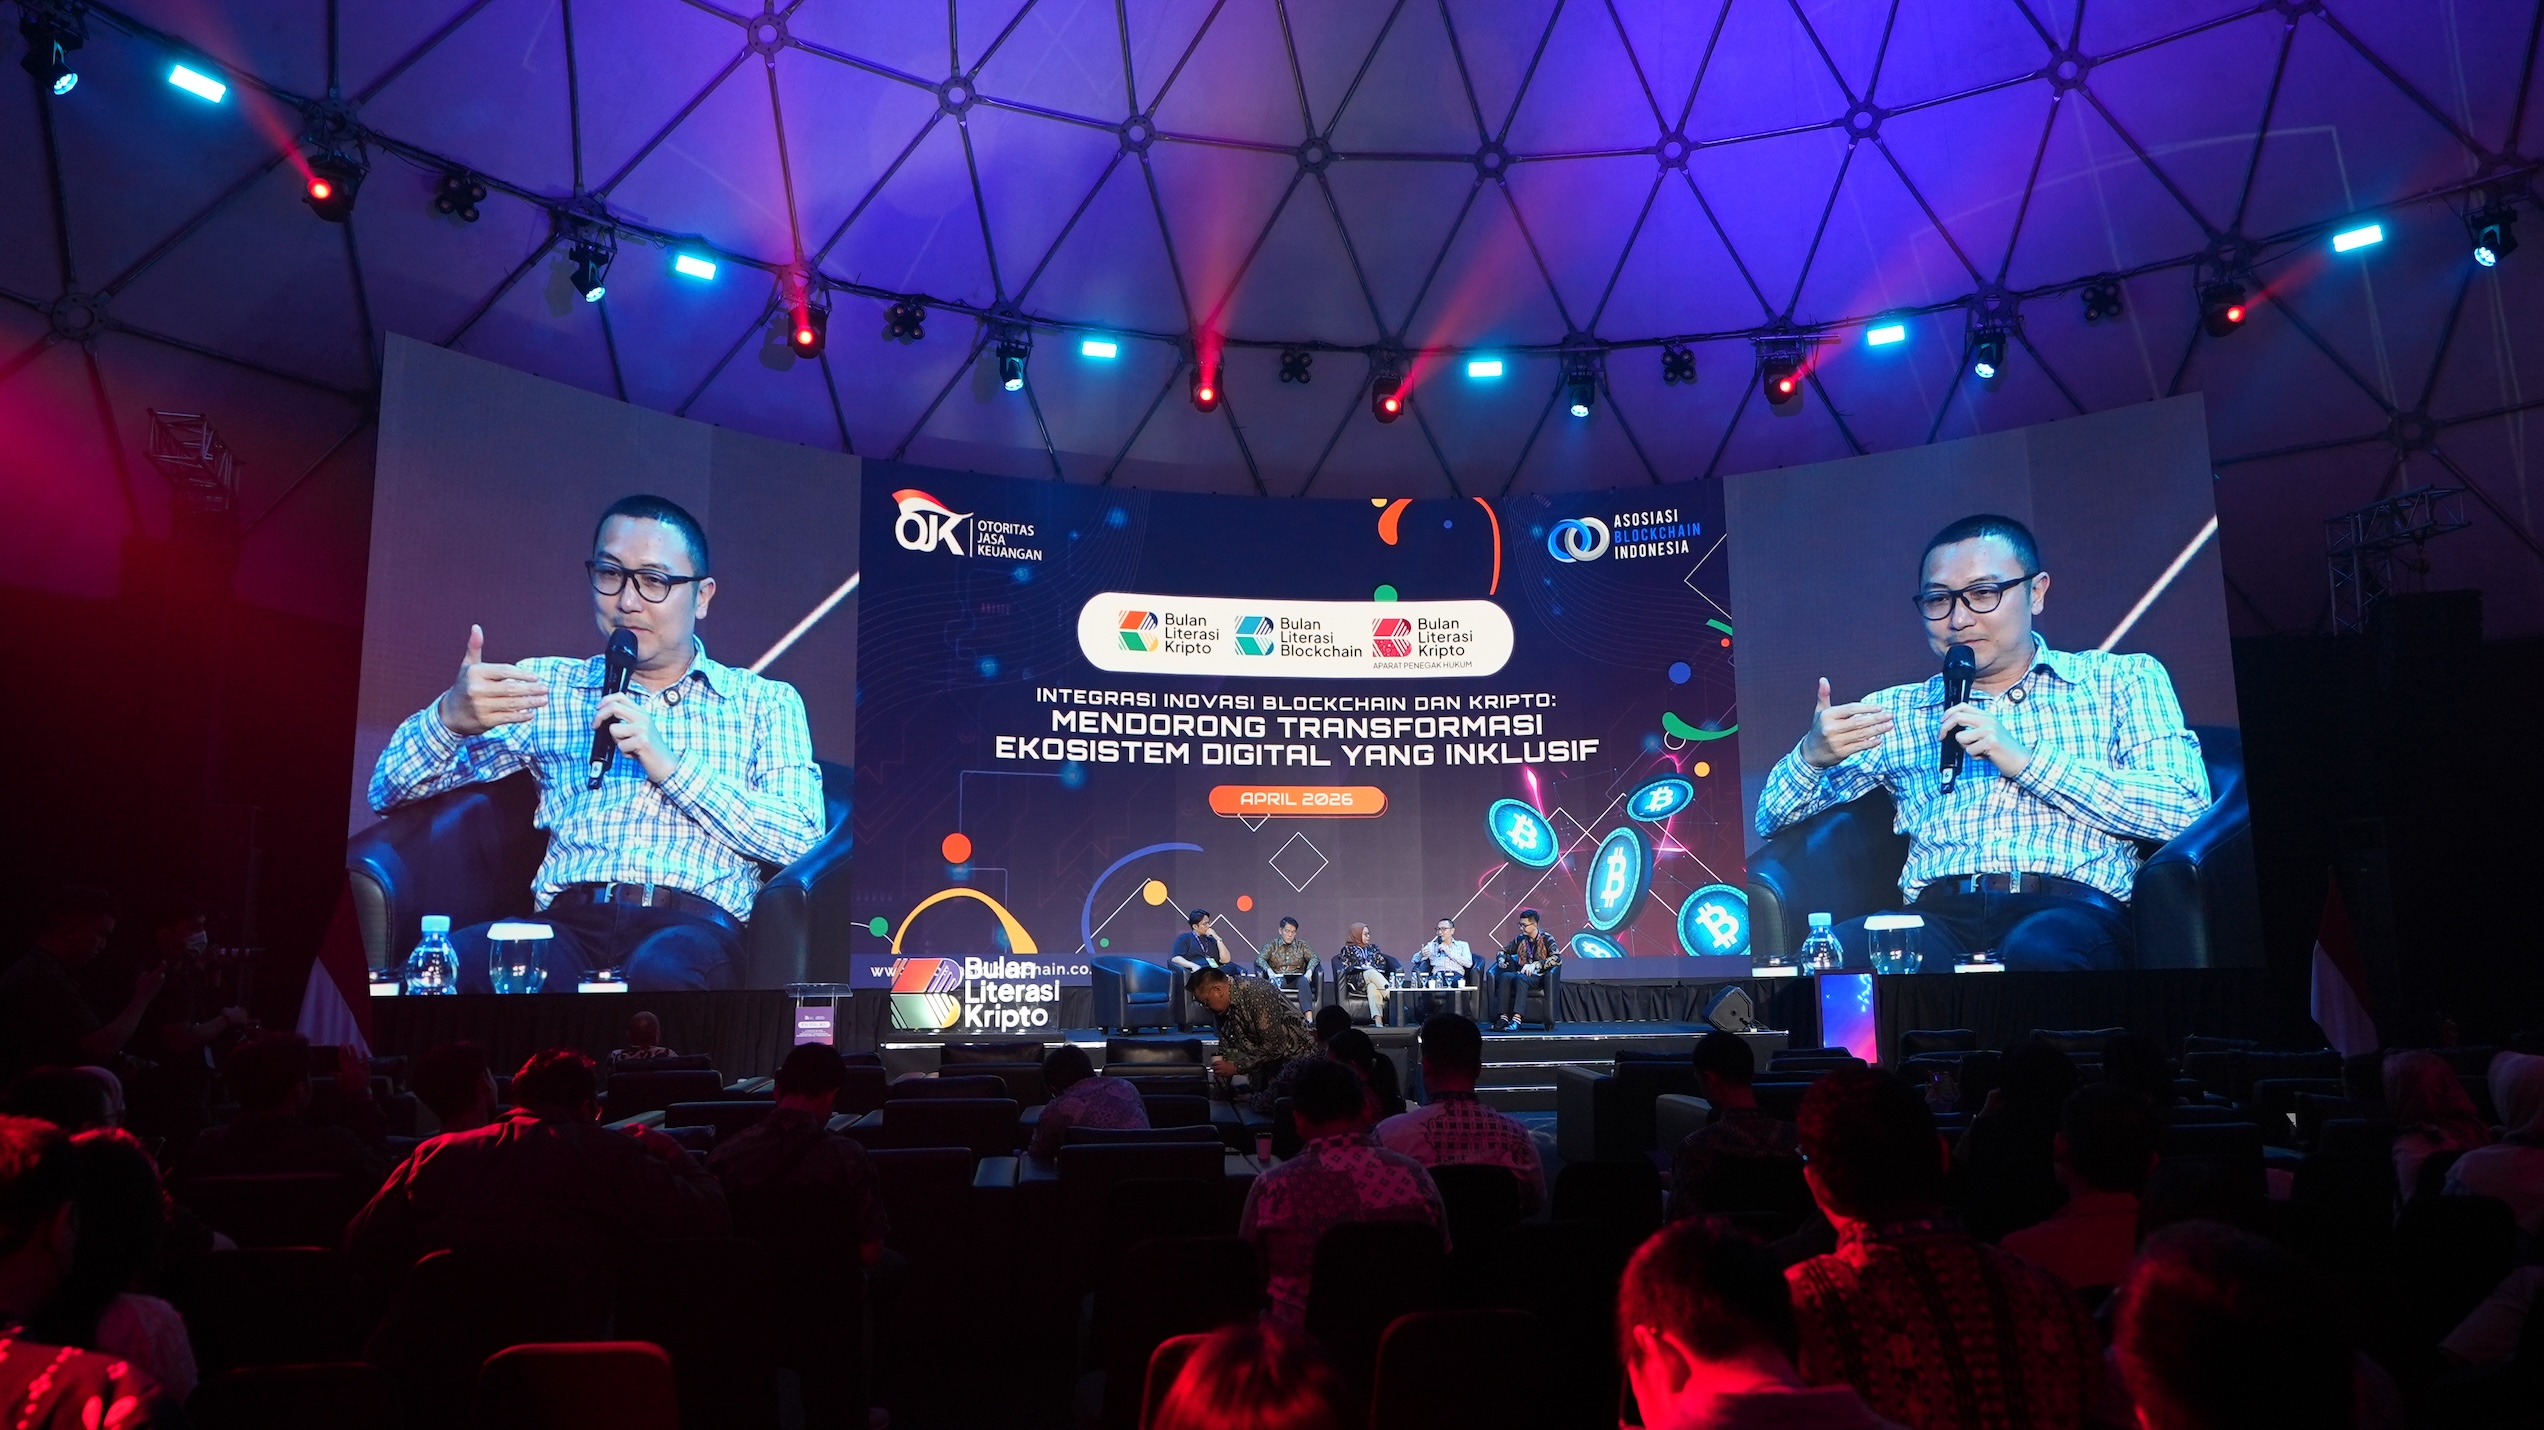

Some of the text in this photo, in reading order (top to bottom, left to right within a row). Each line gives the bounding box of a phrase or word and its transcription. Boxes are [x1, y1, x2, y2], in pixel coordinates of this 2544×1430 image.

[1614, 509, 1677, 527] ASOSIASI
[977, 519, 1035, 536] OTORITAS
[1614, 522, 1701, 543] BLOCKCHAIN
[977, 532, 1006, 546] JASA
[977, 544, 1042, 561] KEUANGAN
[1615, 540, 1689, 559] INDONESIA
[1166, 613, 1206, 626] Bulan
[1281, 618, 1320, 630] Bulan
[1418, 617, 1460, 630] Bulan
[1166, 627, 1219, 640] Literasi
[1281, 631, 1333, 644] Literasi
[1418, 630, 1473, 644] Literasi
[1166, 641, 1211, 656] Kripto
[1281, 644, 1362, 657] Blockchain
[1418, 644, 1465, 659] Kripto
[1372, 660, 1473, 670] APARAT PENEGAK HUKUM
[1037, 688, 1556, 711] INTEGRASI INOVASI BLOCKCHAIN DAN KRIPTO:
[1053, 710, 1542, 738] MENDORONG TRANSFORMASI
[996, 736, 1599, 766] EKOSISTEM DIGITAL YANG INKLUSIF
[1241, 793, 1353, 806] APRIL 2026
[964, 956, 1036, 980] Bulan
[965, 980, 1059, 1003] Literasi
[964, 1004, 1048, 1033] Kripto
